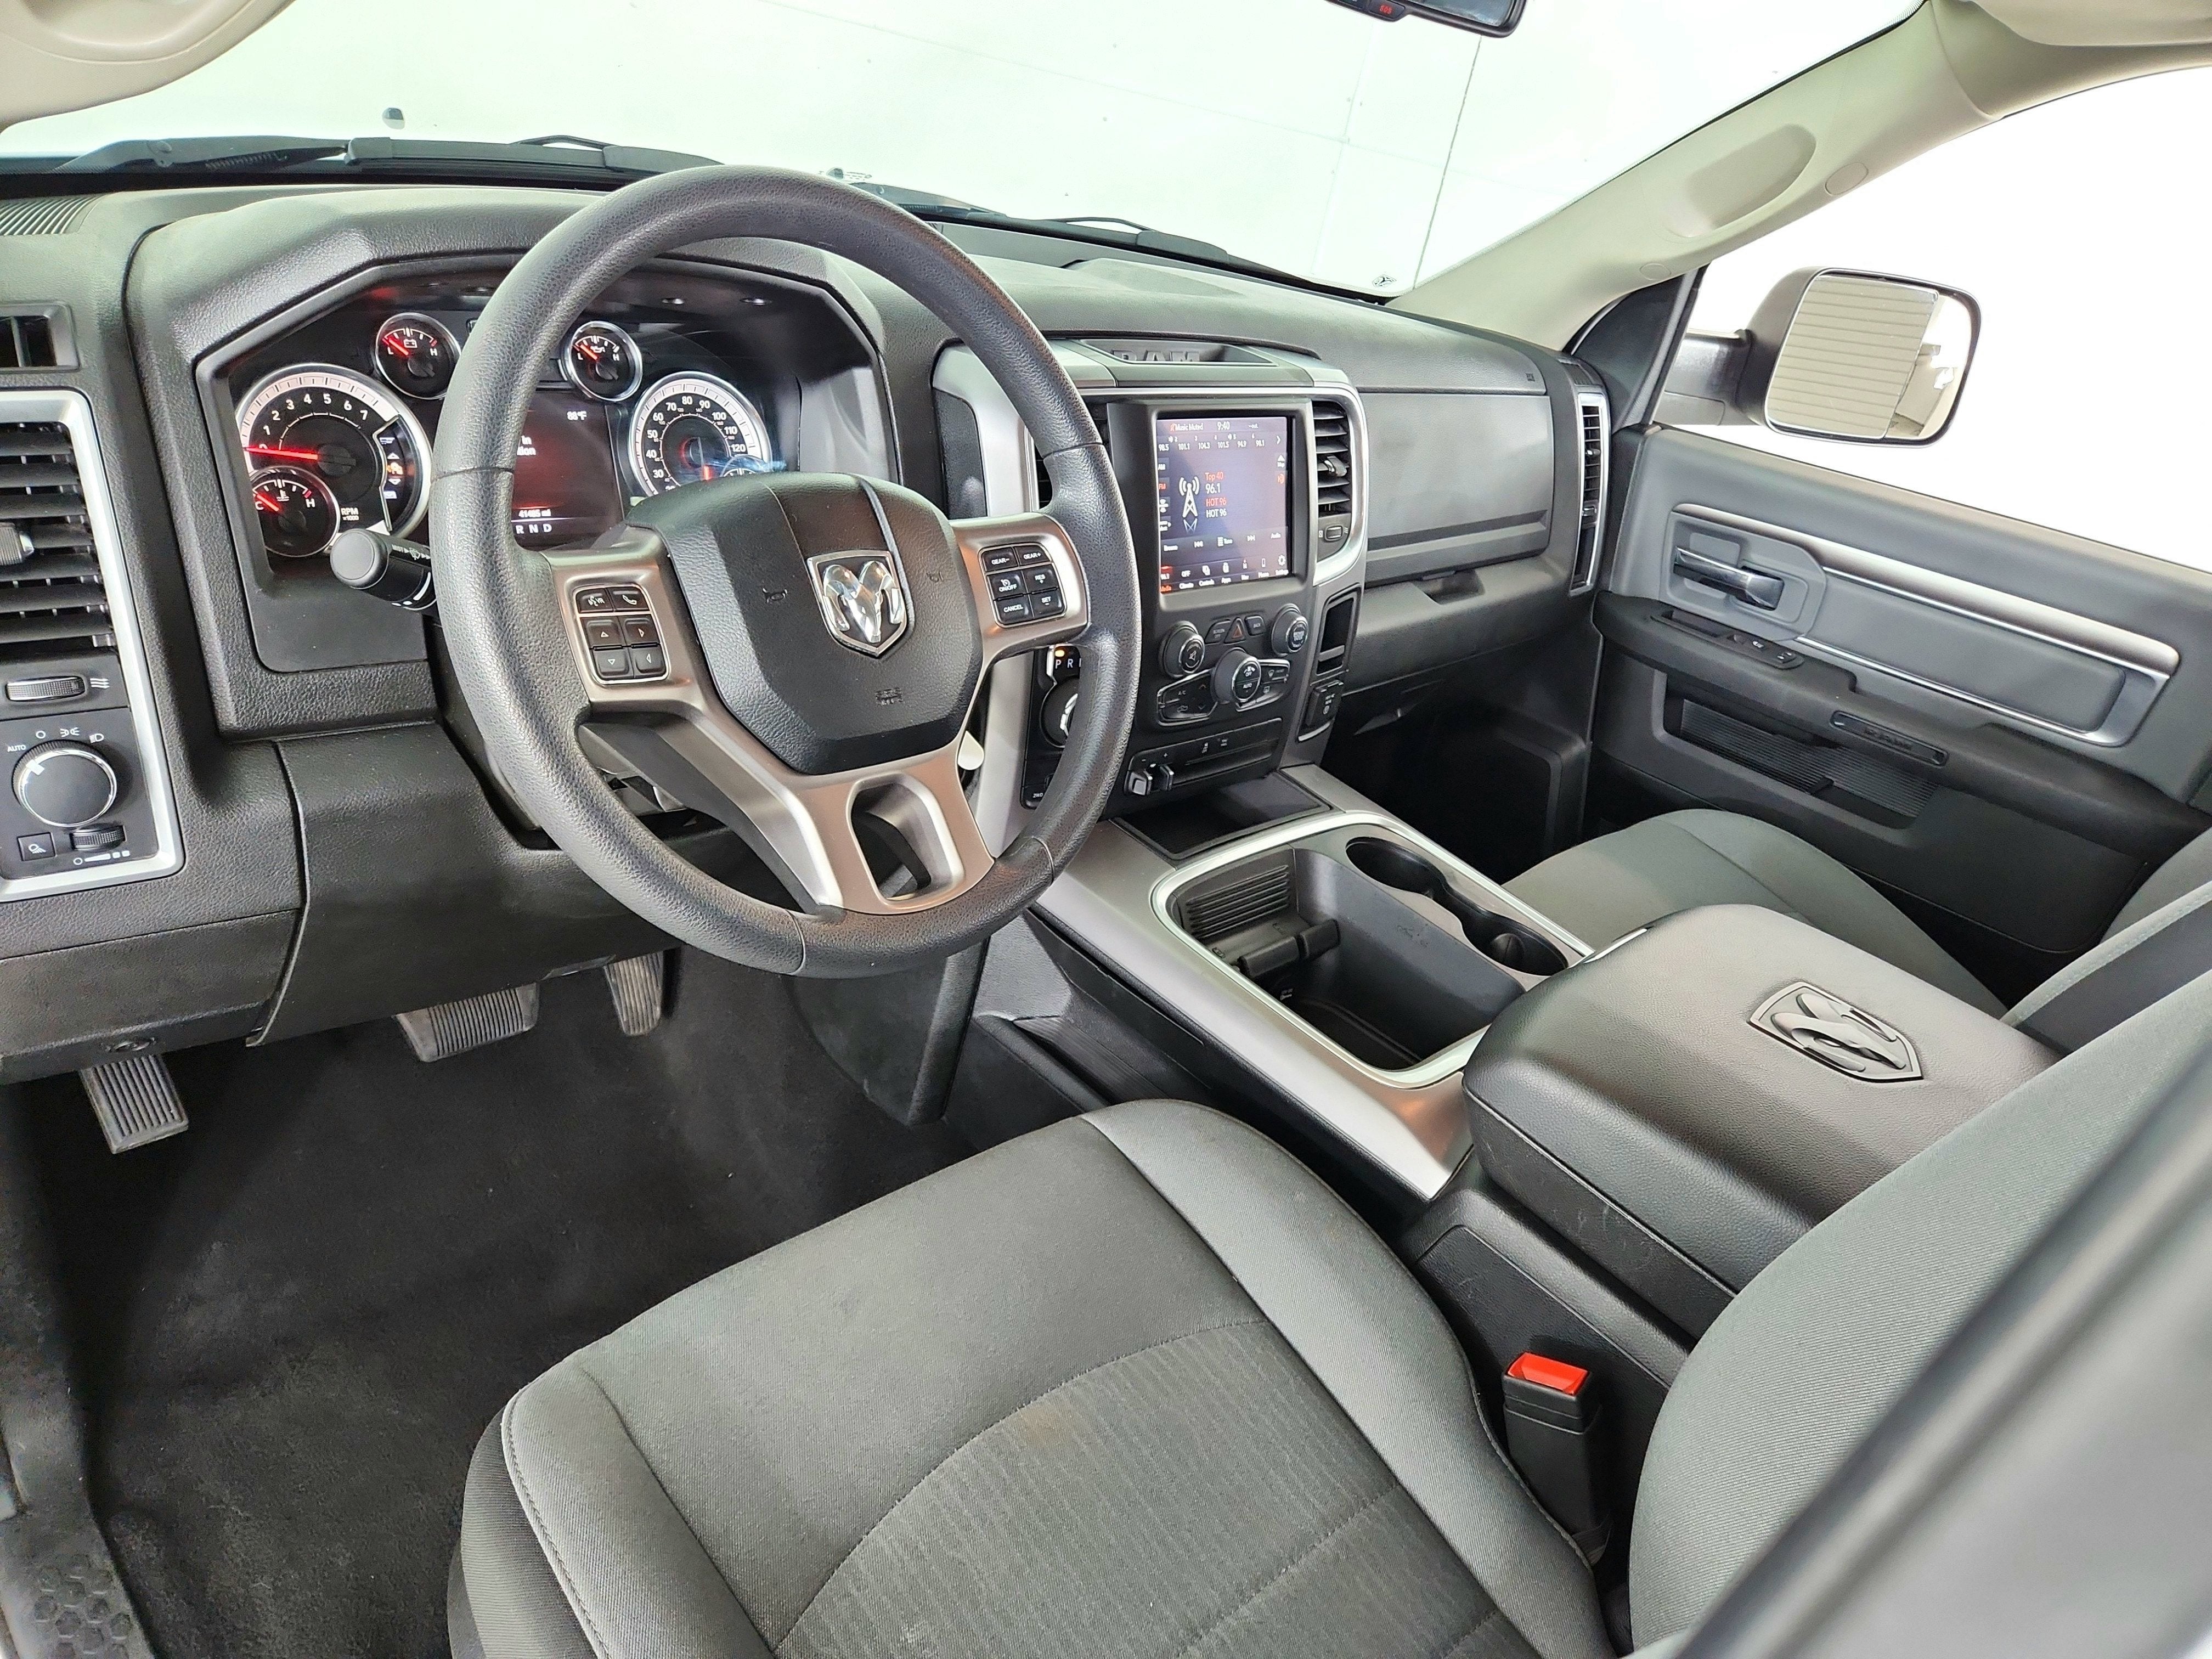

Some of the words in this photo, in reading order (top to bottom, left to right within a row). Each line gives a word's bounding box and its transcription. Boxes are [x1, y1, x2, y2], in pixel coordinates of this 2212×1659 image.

[1379, 4, 1392, 14] SOS
[387, 347, 394, 355] L
[430, 348, 438, 356] H
[577, 352, 584, 360] L
[304, 394, 312, 404] 4
[323, 393, 331, 404] 5
[682, 396, 693, 405] 80
[286, 399, 295, 410] 3
[343, 400, 352, 410] 6
[665, 402, 677, 411] 70
[699, 400, 710, 409] 90
[272, 410, 280, 421] 2
[360, 410, 368, 420] 7
[653, 413, 664, 421] 60
[712, 411, 727, 420] 100
[263, 425, 270, 435] 1
[724, 426, 738, 435] 110
[1175, 423, 1188, 431] Music
[1189, 422, 1204, 431] Muted
[1217, 421, 1231, 431] 9:40
[647, 430, 658, 438] 50
[731, 444, 746, 452] 120
[646, 449, 657, 459] 40
[652, 469, 664, 478] 30
[1205, 472, 1216, 482] Top
[1216, 471, 1224, 480] 40
[1205, 483, 1221, 494] 96.1
[255, 501, 264, 510] C
[305, 498, 315, 507] H
[1206, 498, 1218, 507] HOT
[1219, 497, 1227, 505] 96
[341, 507, 359, 516] RPM
[1206, 509, 1219, 518] HOT
[1219, 508, 1227, 516] 96
[515, 525, 524, 534] R
[528, 524, 539, 533] N
[543, 523, 552, 533] D
[998, 584, 1017, 592] ON/OFF
[1003, 604, 1024, 613] CANCEL
[1055, 659, 1062, 669] P
[1067, 658, 1074, 668] R
